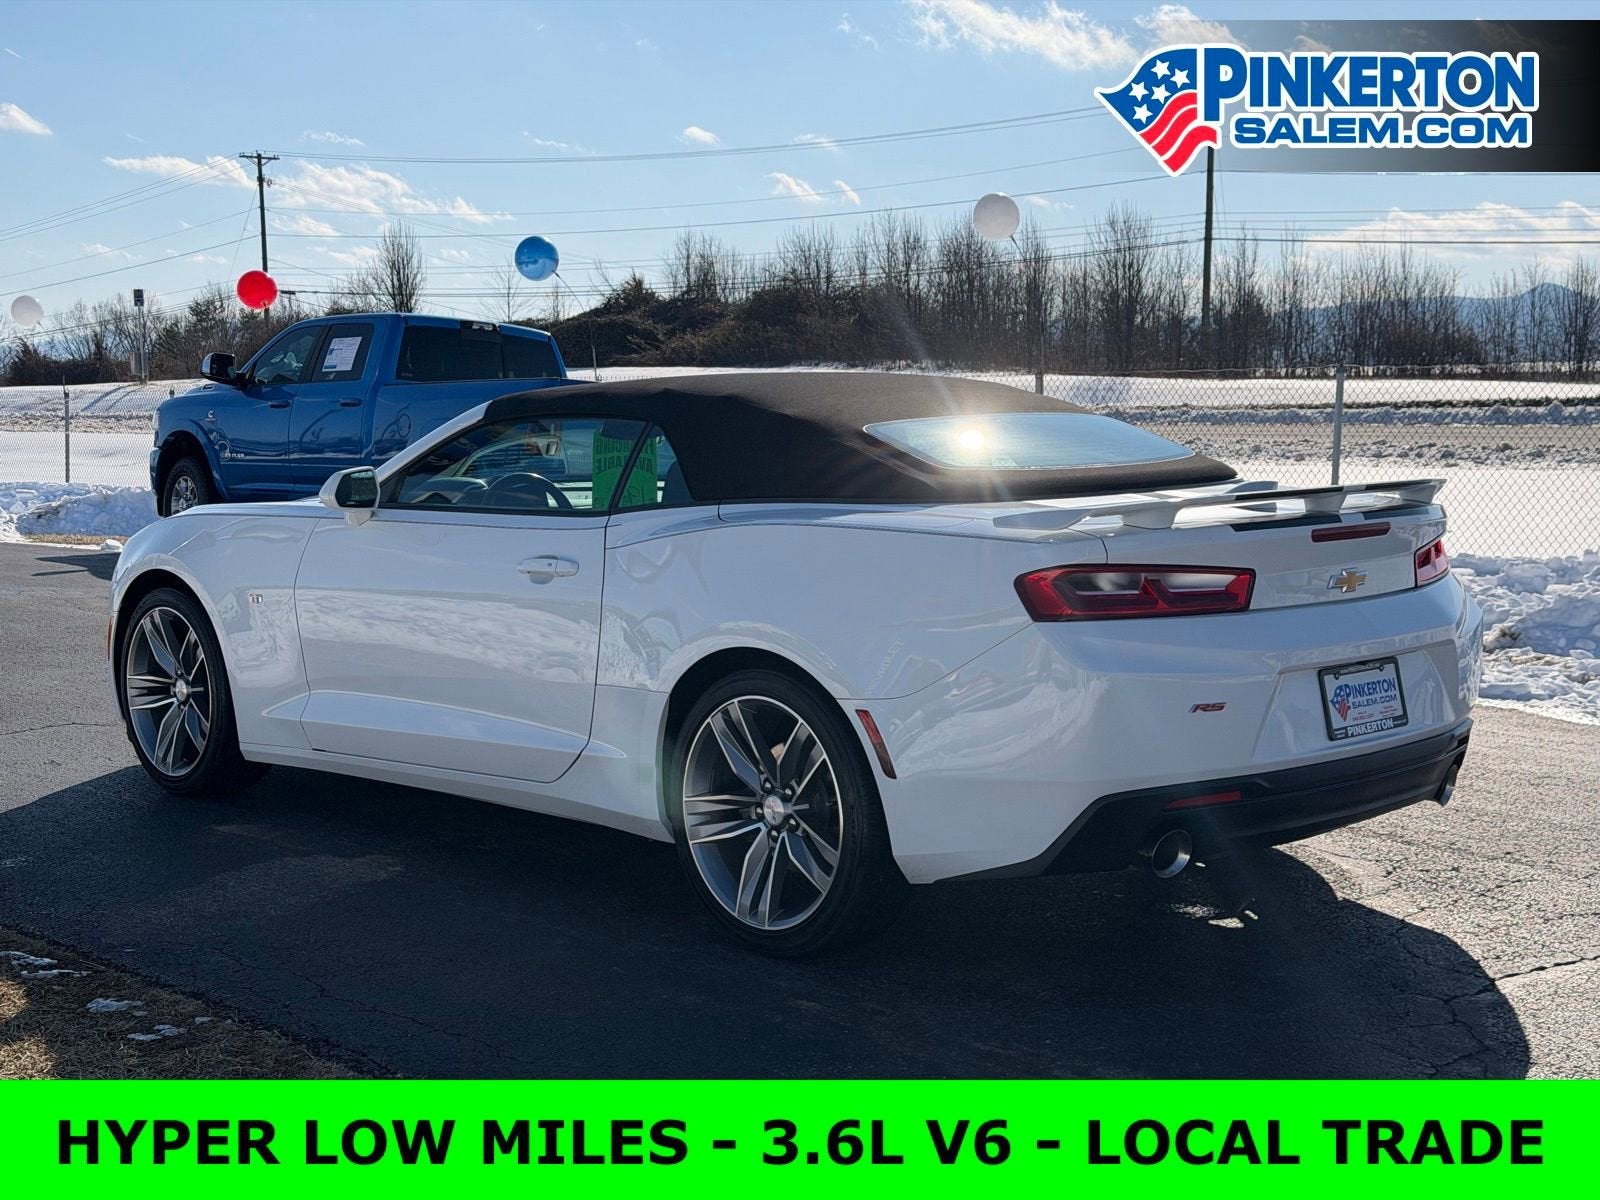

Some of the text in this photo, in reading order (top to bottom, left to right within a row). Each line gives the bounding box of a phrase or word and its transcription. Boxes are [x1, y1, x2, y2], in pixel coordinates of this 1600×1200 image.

[1344, 677, 1397, 703] PINKERTON
[1189, 701, 1227, 714] RS
[1351, 693, 1398, 710] SALEM.COM
[1347, 717, 1394, 737] PINKERTON
